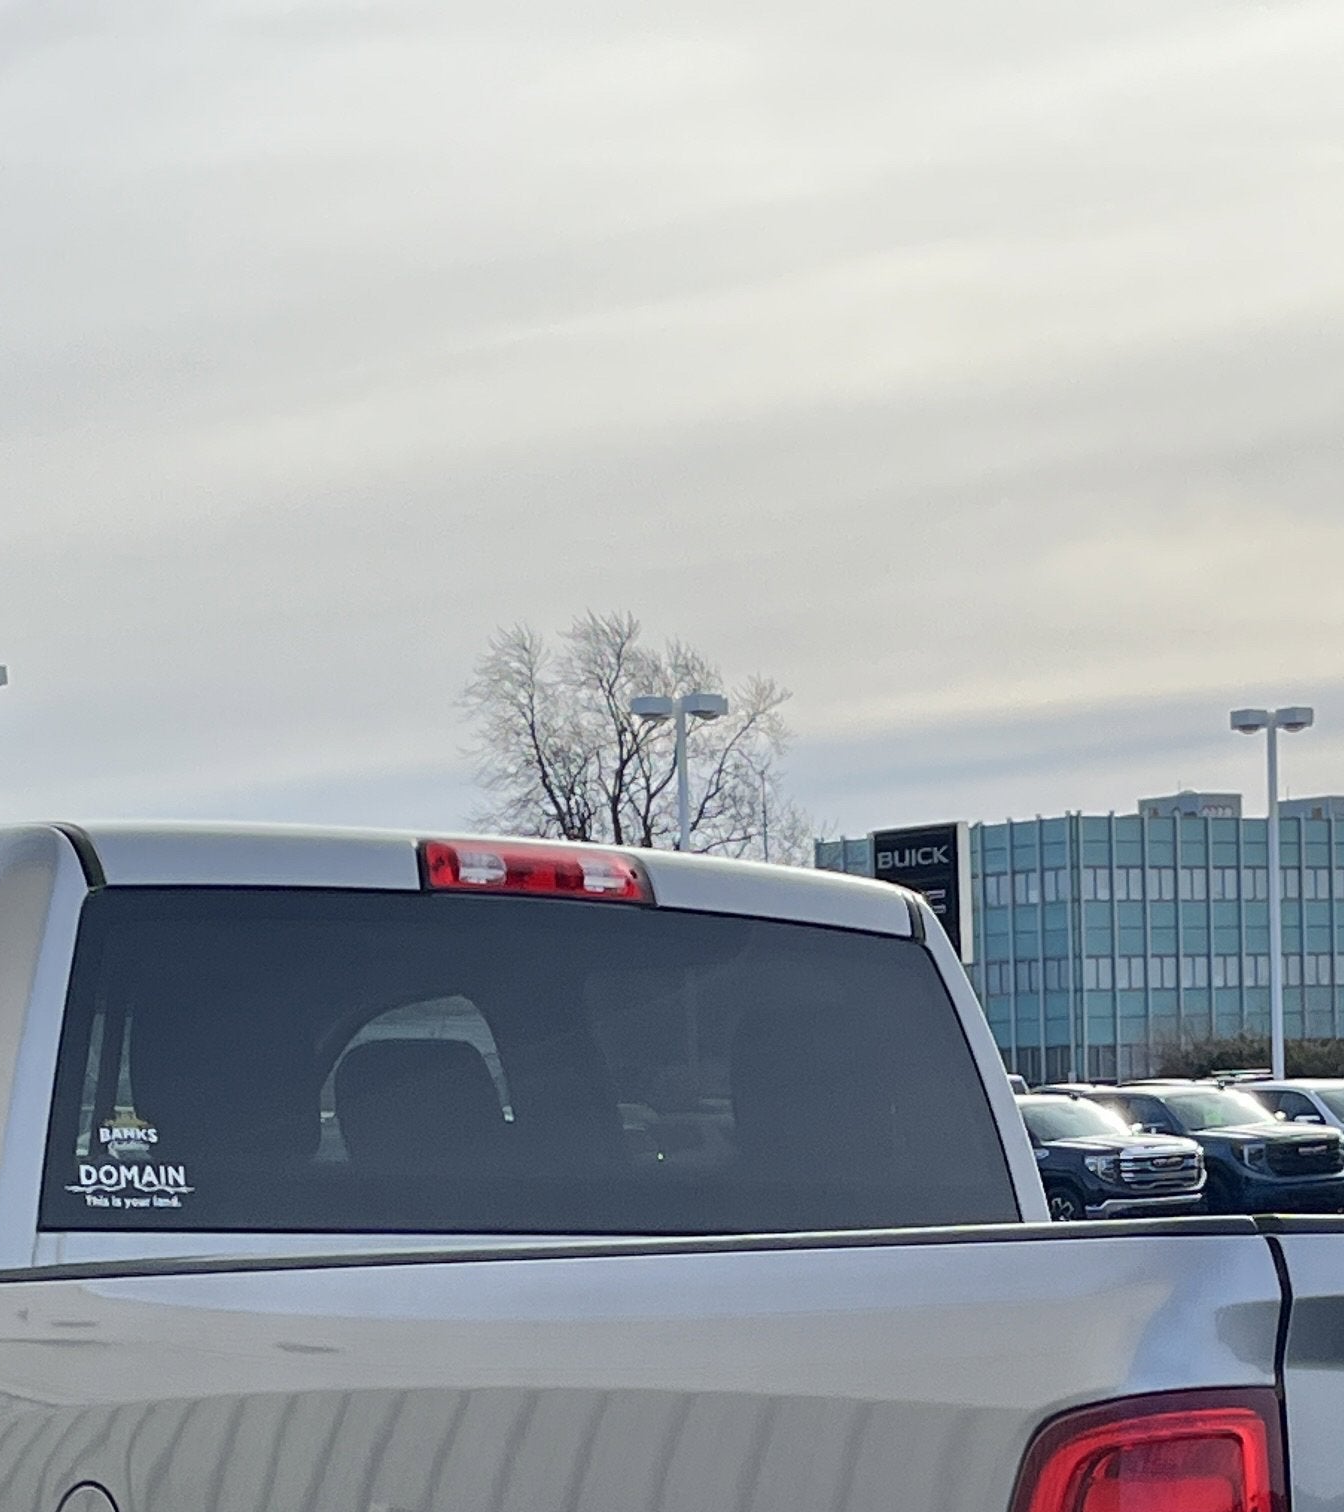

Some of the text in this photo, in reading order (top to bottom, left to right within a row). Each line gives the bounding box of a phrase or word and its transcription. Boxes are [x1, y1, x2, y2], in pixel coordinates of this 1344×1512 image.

[877, 845, 950, 869] BUICK
[99, 1127, 158, 1143] BANKS
[79, 1164, 186, 1187] DOMAIN
[85, 1194, 110, 1207] This
[111, 1194, 122, 1207] is
[123, 1197, 151, 1209] your
